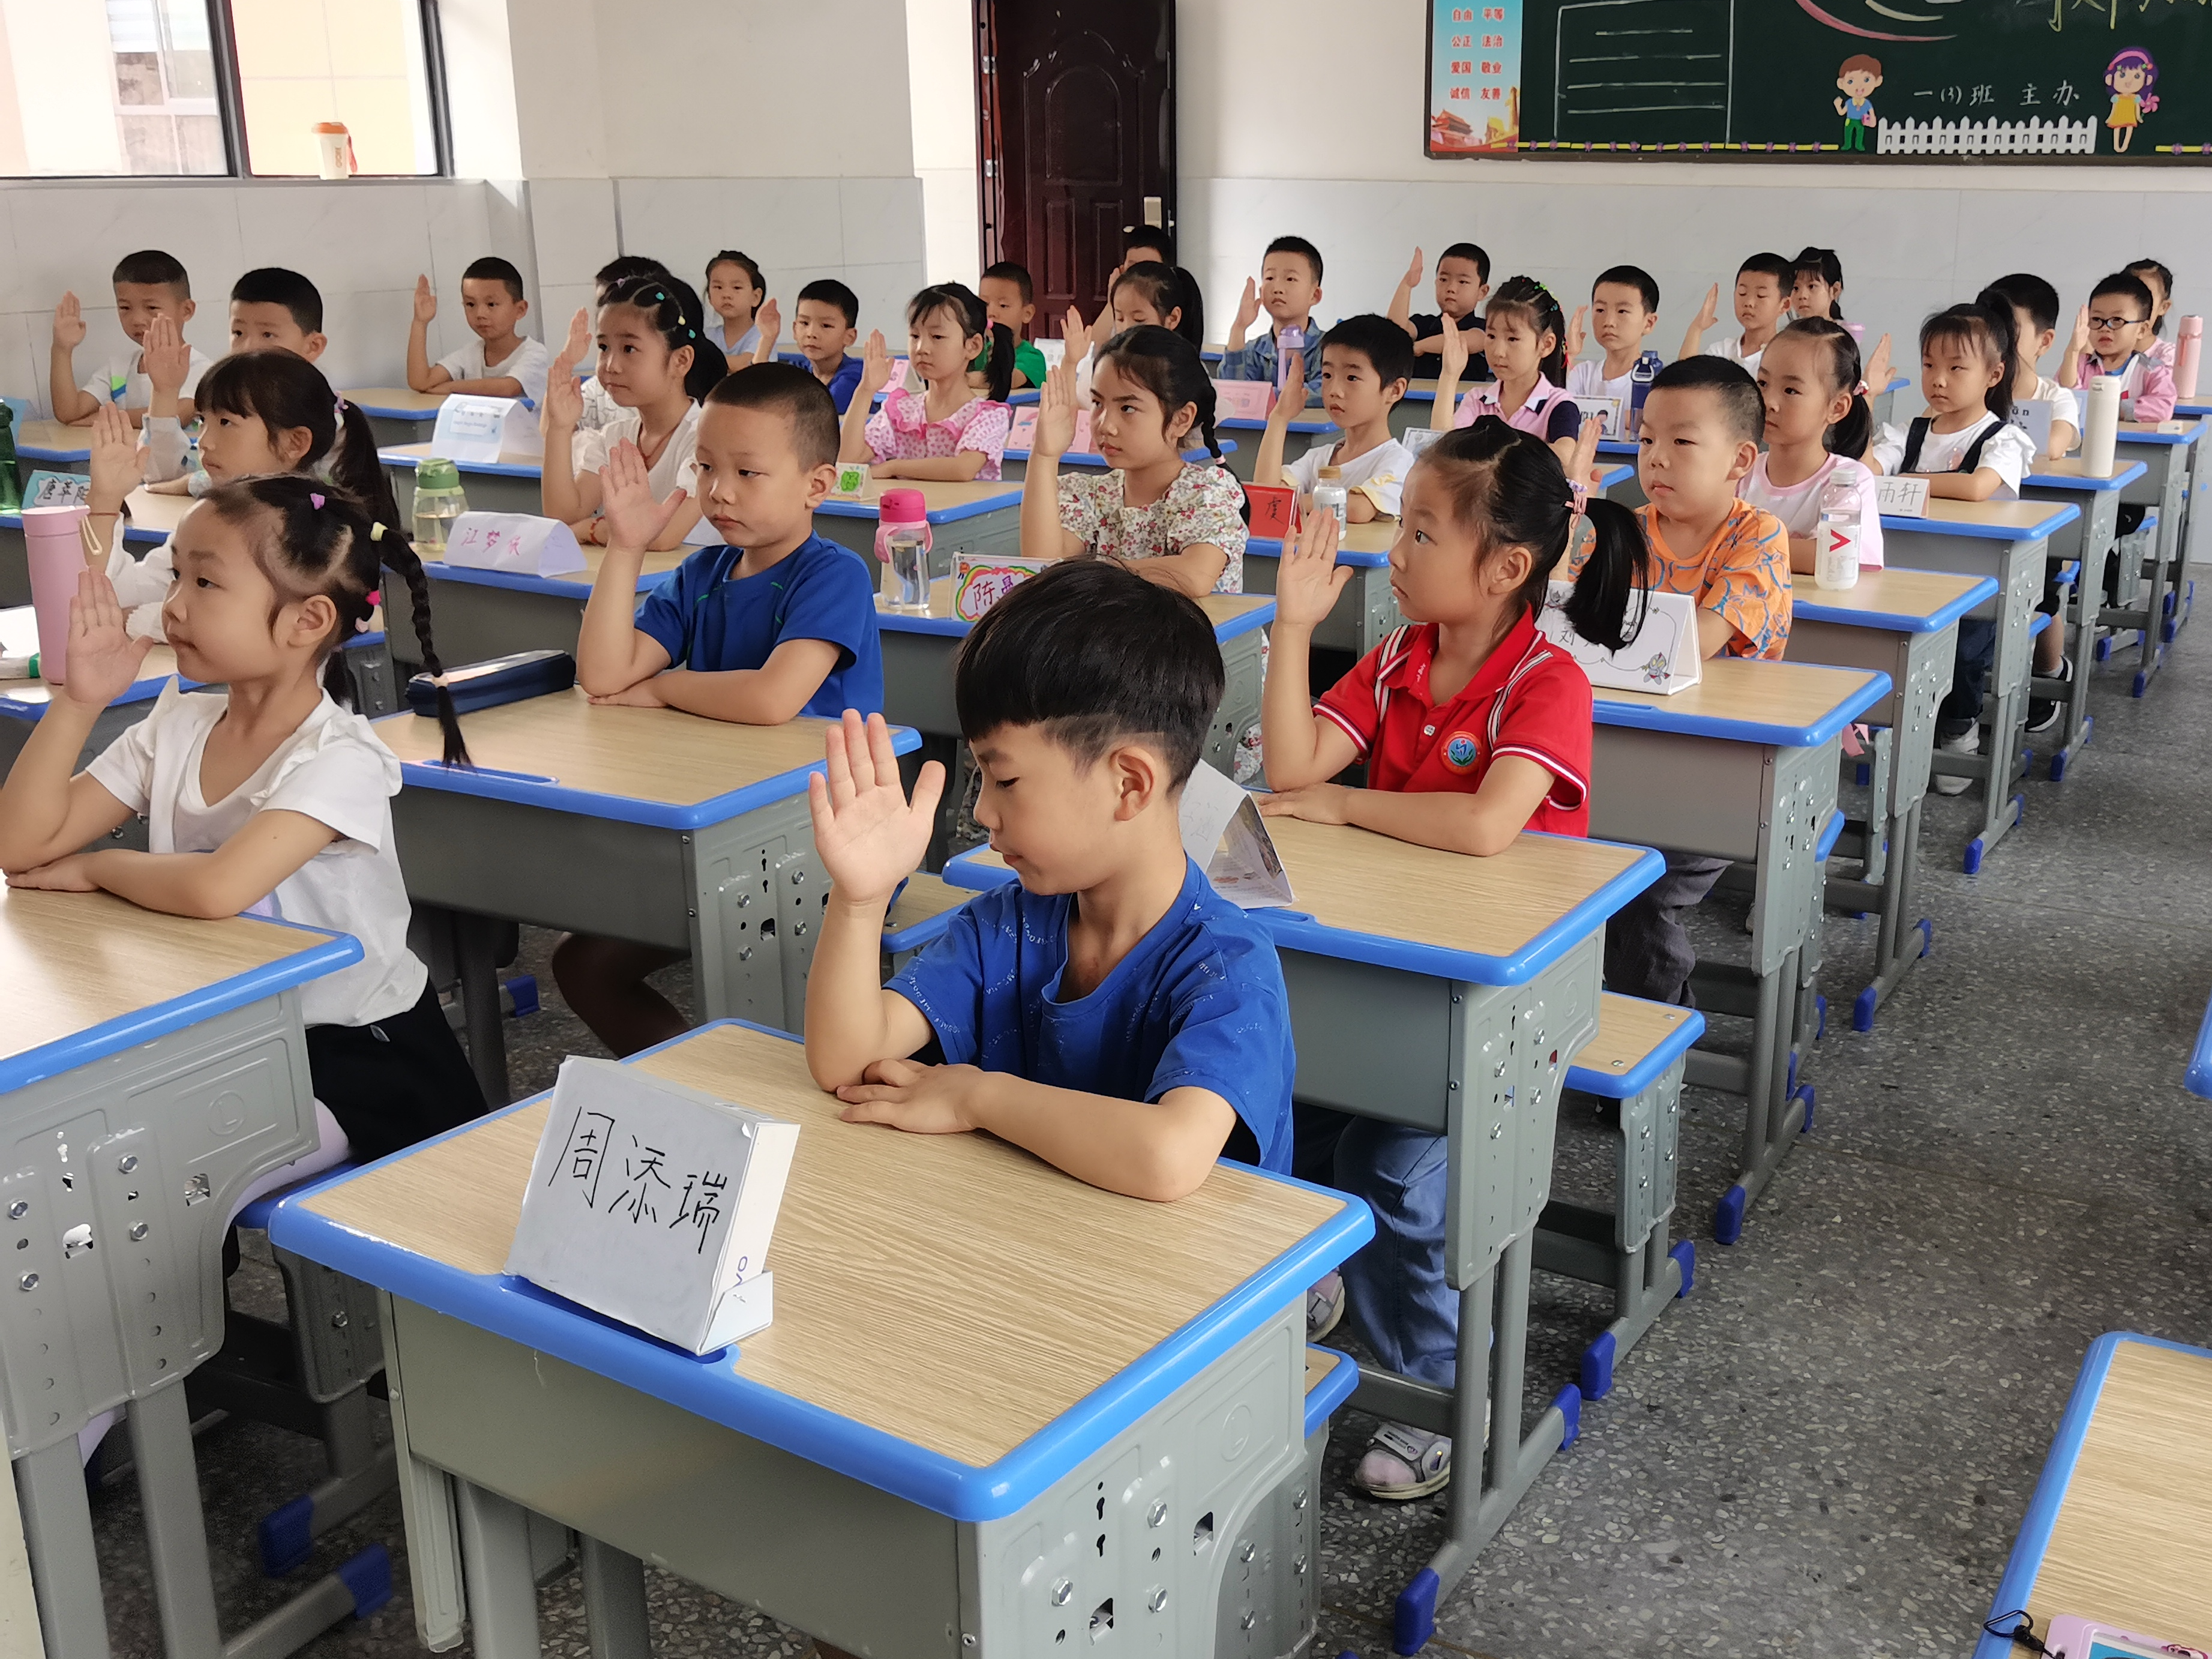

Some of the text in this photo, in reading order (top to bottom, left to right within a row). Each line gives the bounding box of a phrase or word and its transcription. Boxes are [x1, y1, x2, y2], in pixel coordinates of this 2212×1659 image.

[1452, 8, 1473, 21] 自由
[1452, 35, 1503, 47] 公正 法治
[1451, 61, 1501, 74] 爱国 敬业
[1450, 87, 1500, 100] 诚信 友善
[1877, 481, 1922, 505] 雨轩
[548, 1106, 727, 1254] 周添瑞
